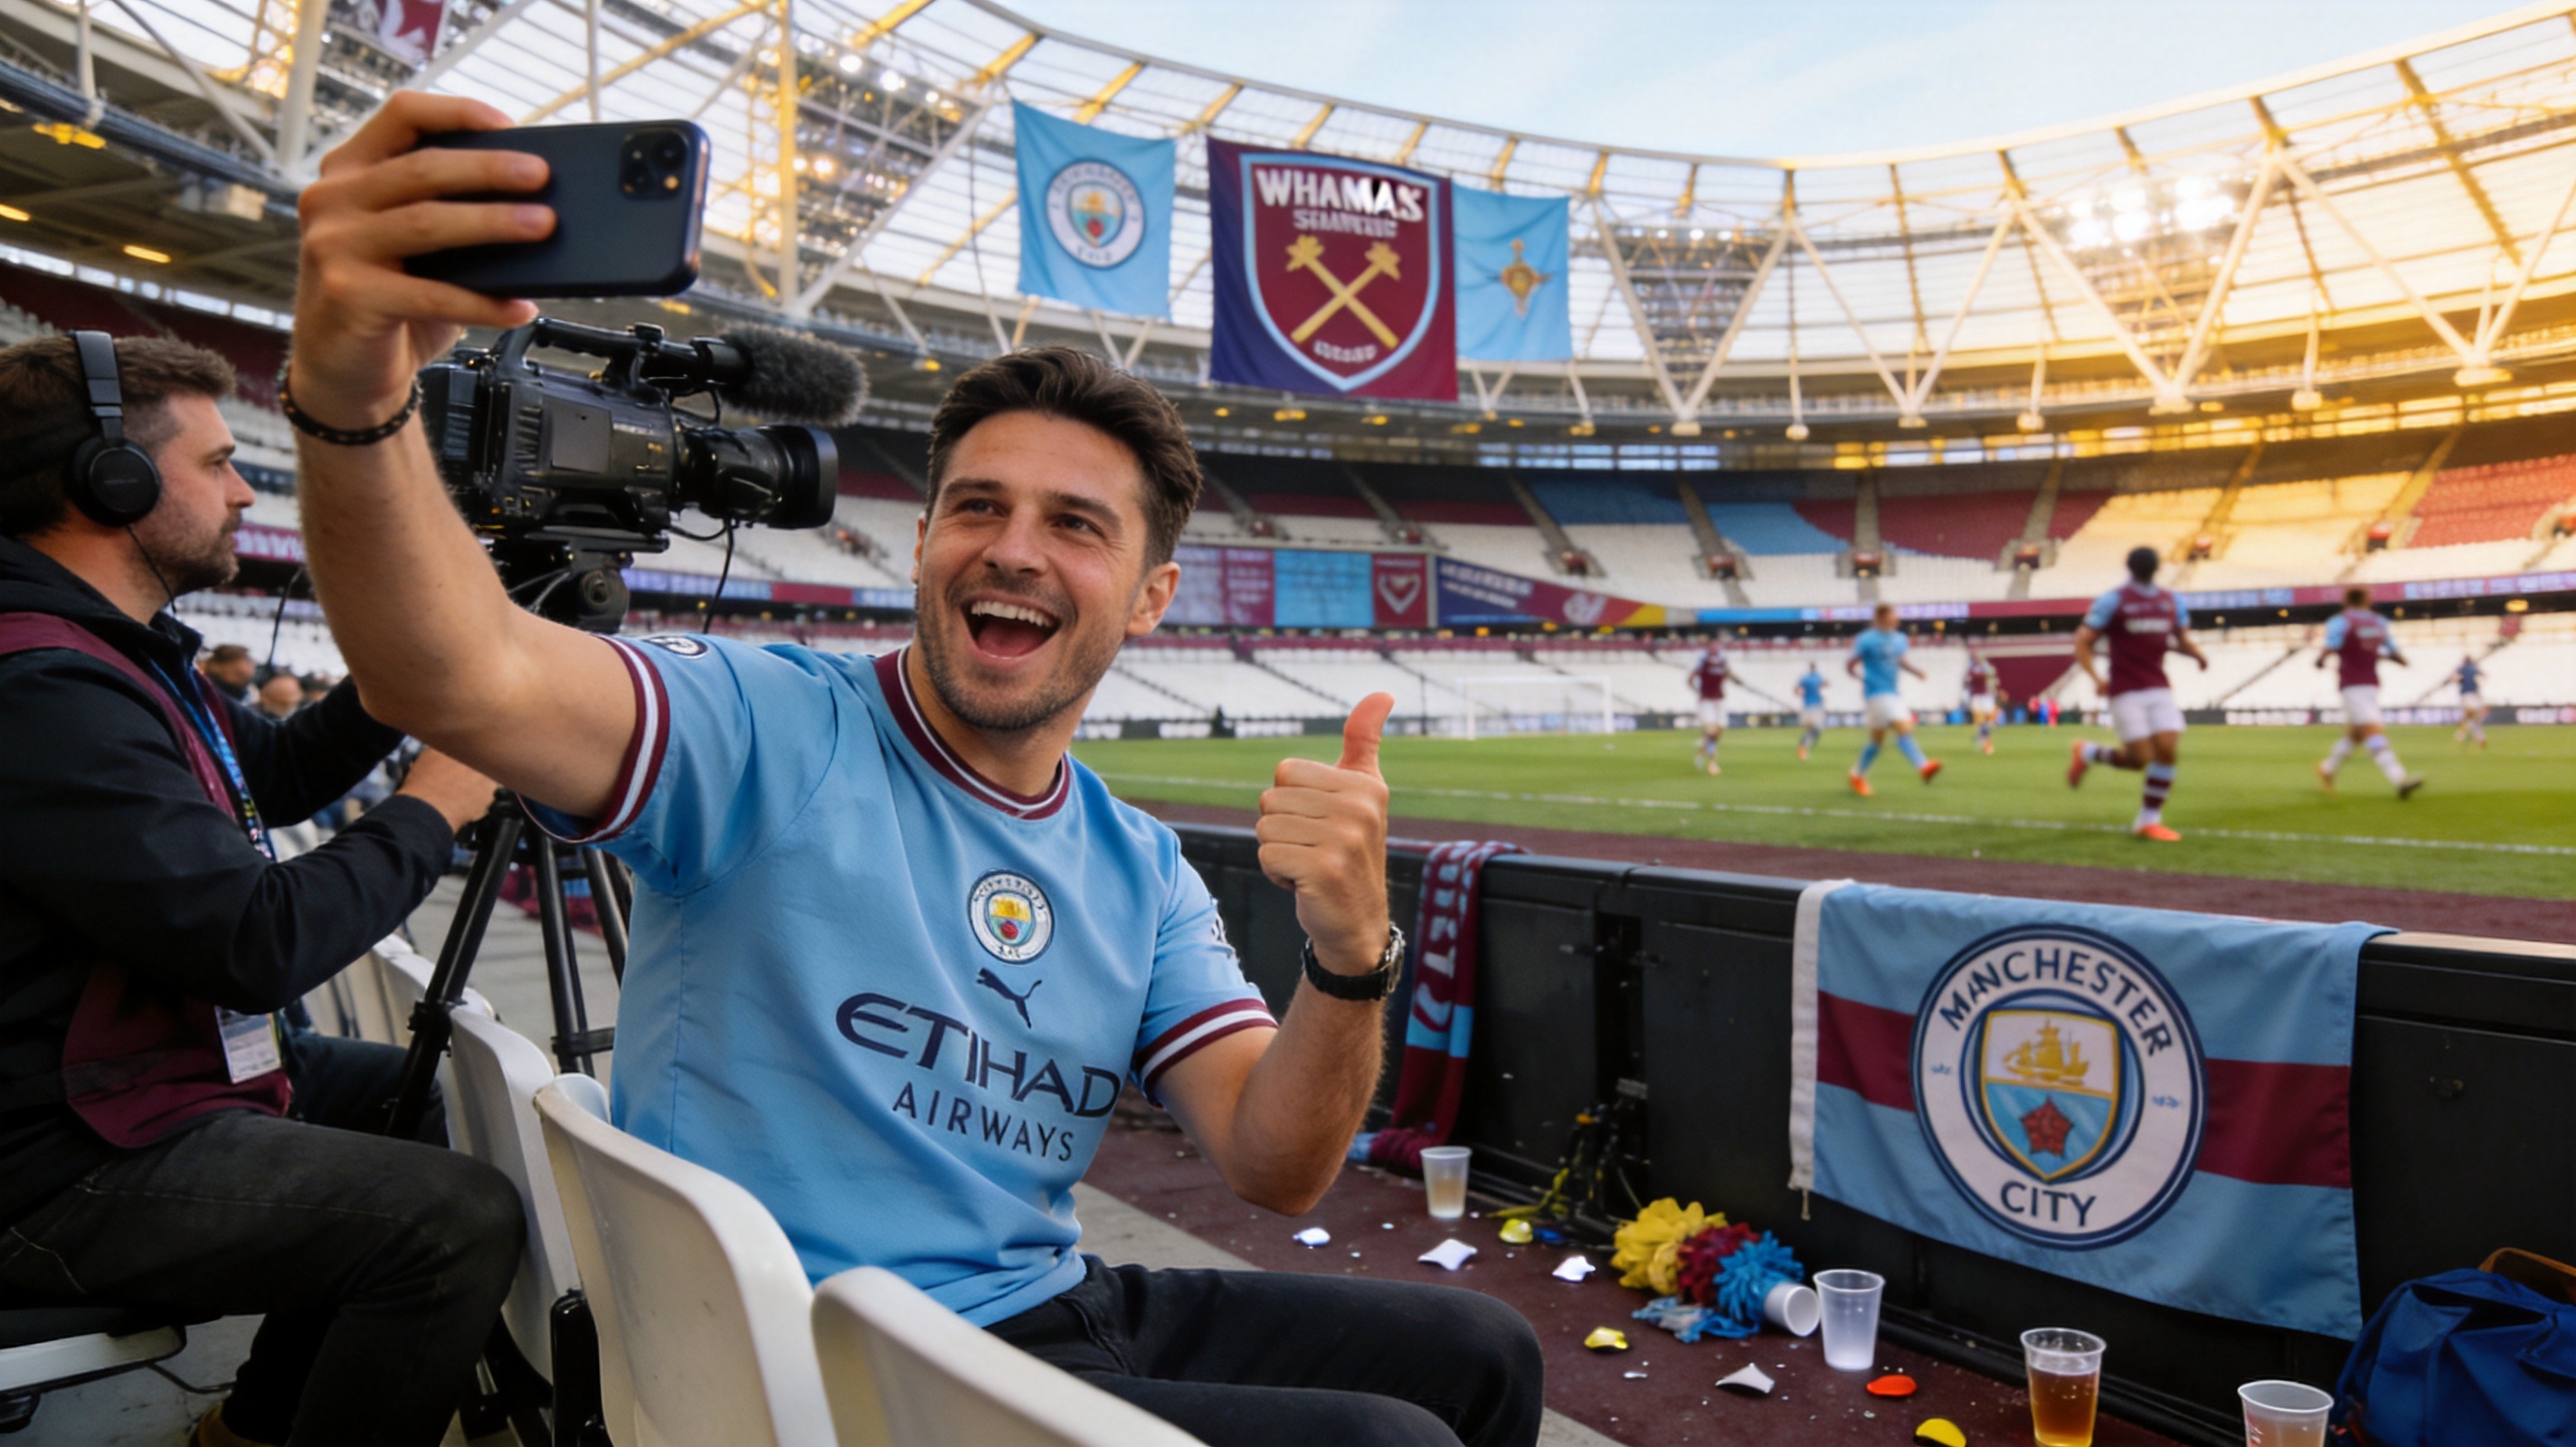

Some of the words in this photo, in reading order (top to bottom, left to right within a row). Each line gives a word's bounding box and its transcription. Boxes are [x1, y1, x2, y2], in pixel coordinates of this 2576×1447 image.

[1939, 948, 2173, 1057] MANCHESTER
[836, 992, 1121, 1118] ETIHAD
[892, 1081, 1074, 1162] AIRWAYS
[2000, 1180, 2097, 1227] CITY
